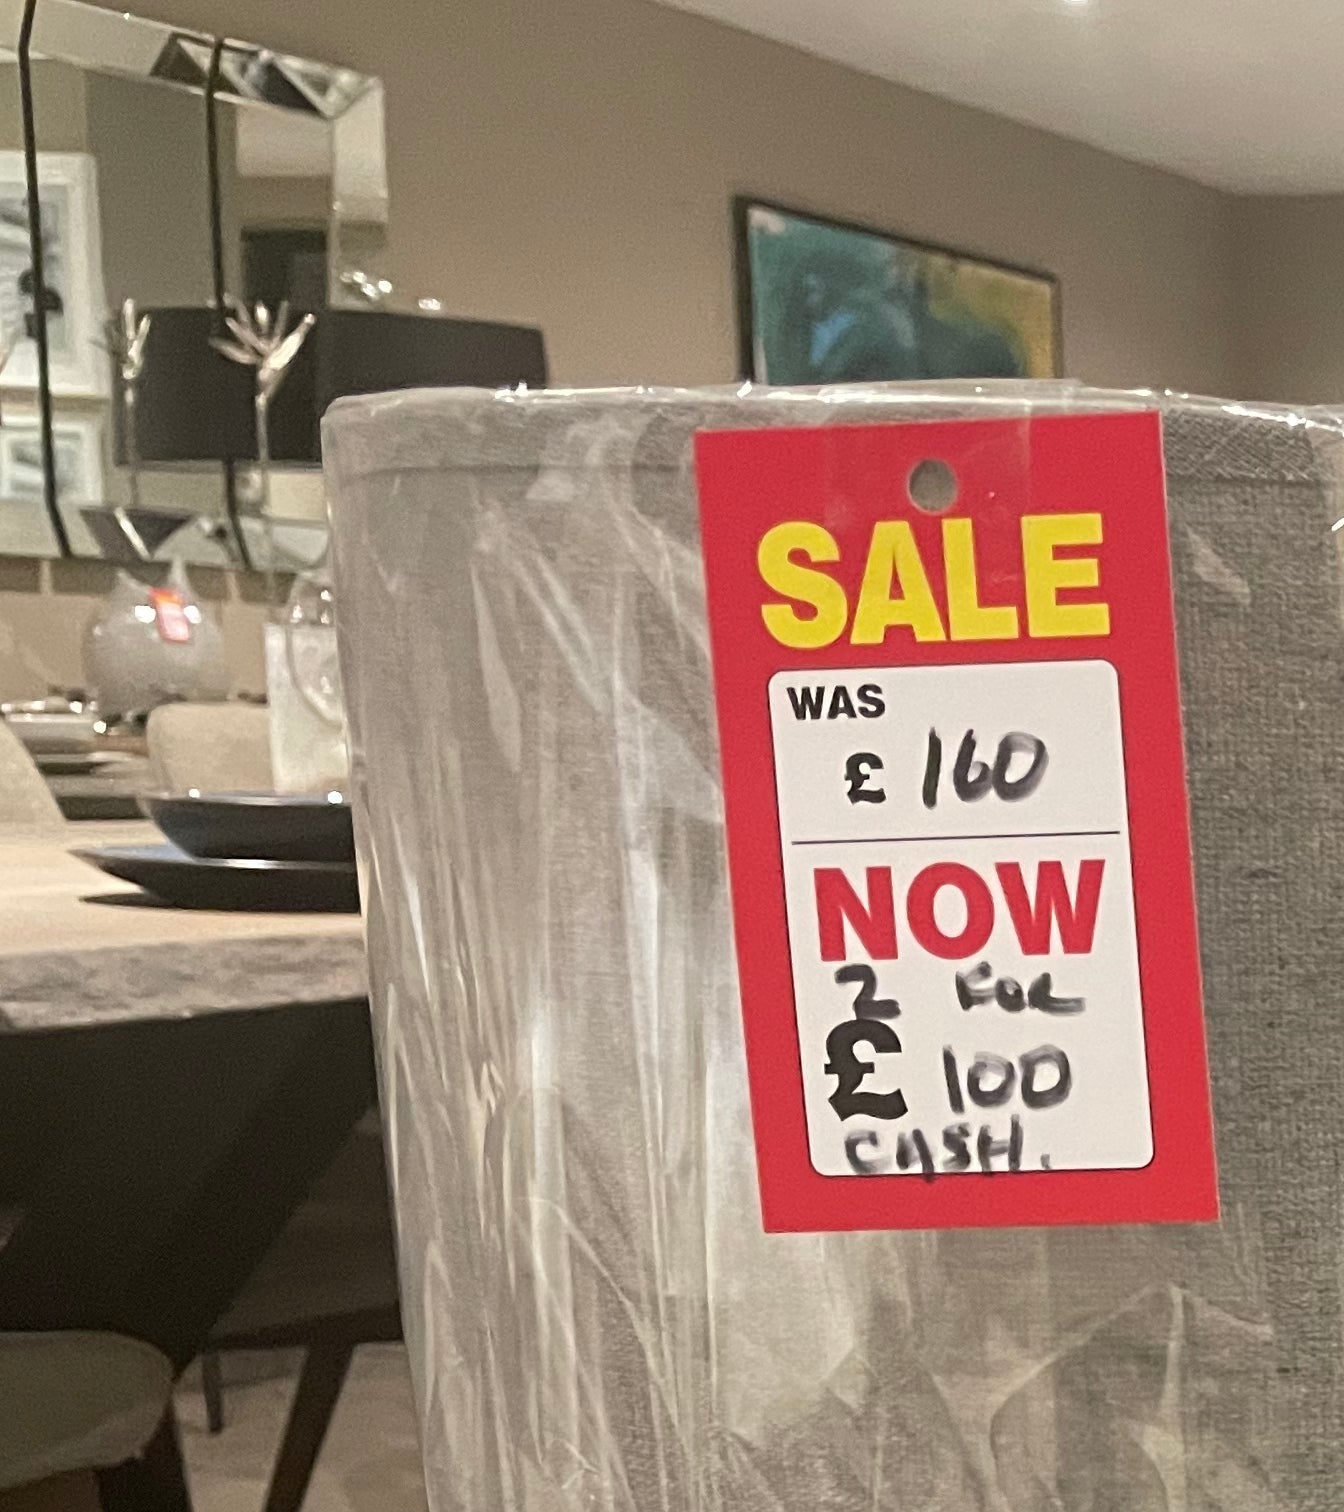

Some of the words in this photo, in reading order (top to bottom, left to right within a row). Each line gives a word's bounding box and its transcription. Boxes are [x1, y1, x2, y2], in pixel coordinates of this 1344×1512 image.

[756, 512, 1111, 651] SALE
[786, 683, 886, 721] WAS
[844, 752, 887, 806] £
[922, 725, 1051, 811] 160
[813, 858, 1106, 961] NOW
[834, 963, 902, 1020] 2
[823, 1019, 909, 1122] £
[942, 1043, 1073, 1115] 100
